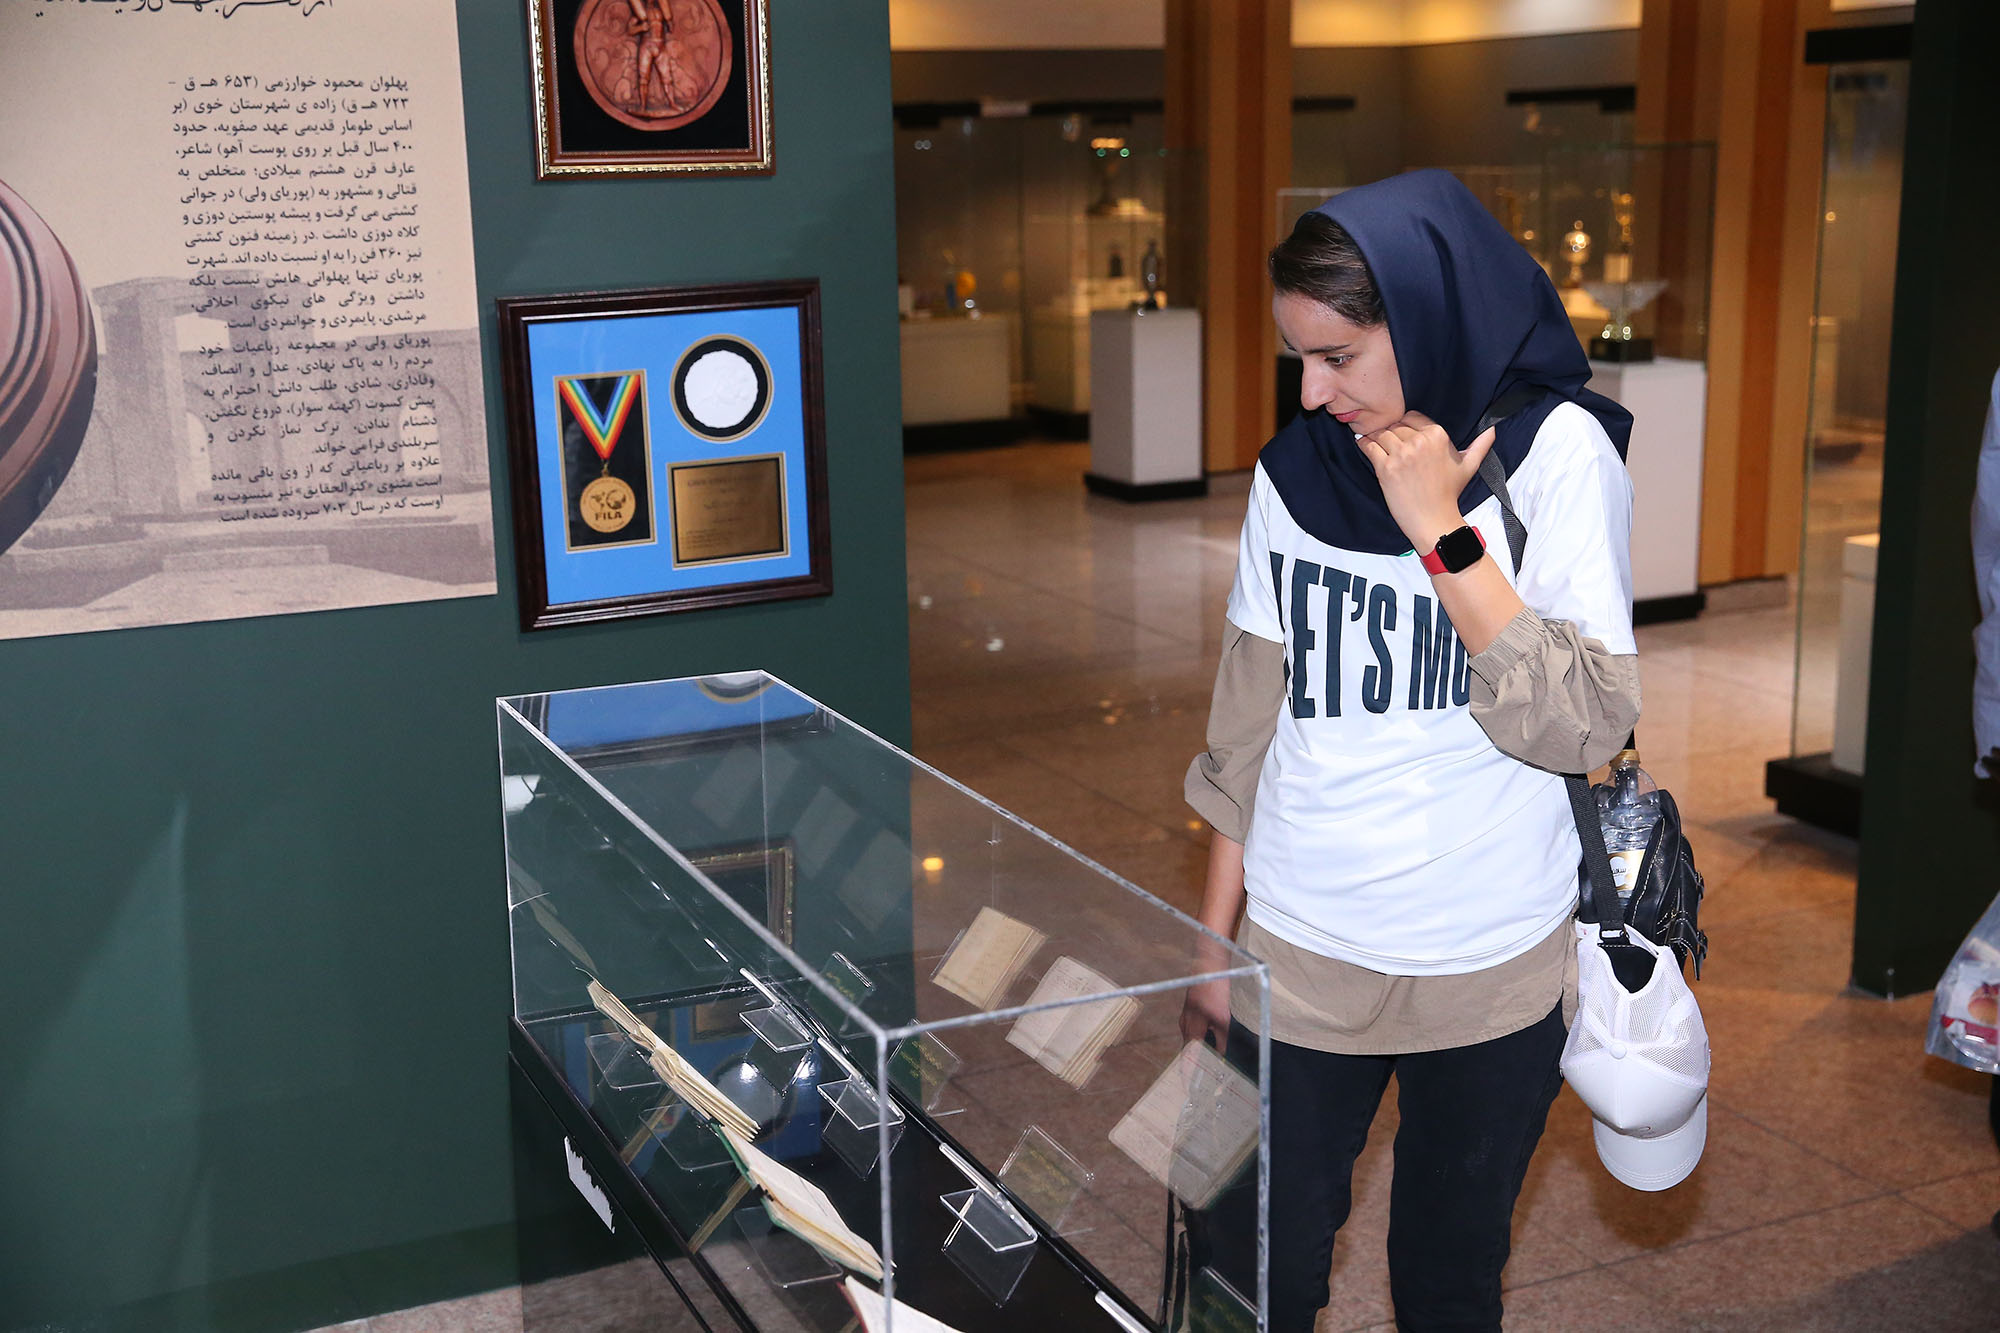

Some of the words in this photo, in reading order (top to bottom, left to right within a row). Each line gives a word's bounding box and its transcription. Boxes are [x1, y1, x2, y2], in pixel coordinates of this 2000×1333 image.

[184, 76, 196, 92] ق
[264, 75, 317, 93] خوارزمی
[323, 78, 364, 92] محمود
[370, 75, 409, 93] پهلوان
[193, 98, 224, 115] خوی
[229, 97, 290, 115] شهرستان
[296, 102, 307, 114] ی
[312, 97, 336, 114] زاده
[173, 123, 208, 137] حدود
[262, 123, 289, 136] عهد
[294, 119, 335, 137] قدیمی
[340, 119, 373, 136] طومار
[378, 119, 412, 136] اساس
[248, 145, 288, 159] پوست
[292, 146, 317, 158] روی
[321, 146, 332, 158] بر
[336, 140, 360, 157] قبل
[363, 141, 389, 157] سال
[393, 140, 412, 152] ۴۰۰
[177, 168, 190, 181] به
[198, 164, 247, 182] متخلص
[309, 163, 346, 179] هشتم
[353, 162, 377, 179] قرن
[384, 162, 415, 178] عارف
[180, 186, 217, 204] جوانی
[222, 189, 235, 203] در
[318, 188, 330, 200] به
[333, 184, 374, 201] مشهور
[377, 189, 384, 200] و
[386, 183, 417, 200] قتالی
[182, 214, 190, 226] و
[192, 211, 226, 225] دوزی
[228, 210, 277, 225] پوستین
[279, 207, 312, 223] پیشه
[315, 211, 322, 223] و
[323, 205, 358, 222] گرفت
[361, 210, 379, 222] می
[381, 204, 418, 222] کشتی
[184, 230, 224, 248] کشتی
[228, 229, 259, 247] فنون
[263, 231, 298, 245] زمینه
[322, 227, 358, 240] داشت
[362, 228, 393, 243] دوزی
[397, 225, 420, 238] کلاه
[186, 252, 228, 269] شهرت
[231, 251, 251, 264] اند.
[253, 250, 278, 263] داده
[280, 250, 318, 265] نسبت
[321, 249, 331, 265] او
[333, 252, 345, 264] به
[346, 248, 357, 264] را
[359, 247, 376, 264] فن
[378, 247, 401, 259] ۳۶۰
[406, 247, 422, 263] نیز
[188, 274, 217, 291] بلکه
[222, 273, 260, 289] نیست
[265, 271, 301, 289] هایش
[306, 270, 351, 288] پهلوانی
[355, 269, 379, 285] تنها
[385, 268, 423, 284] پوریای
[250, 293, 290, 311] نیکوی
[301, 292, 326, 309] های
[338, 290, 376, 308] ویژگی
[387, 288, 425, 305] داشتن
[224, 315, 256, 329] است.
[258, 314, 317, 332] جوانمردی
[320, 317, 327, 329] و
[328, 311, 376, 328] پایمردی
[232, 339, 280, 356] رباعیات
[287, 341, 336, 354] مجموعه
[344, 339, 358, 352] در
[364, 335, 386, 352] ولی
[393, 333, 432, 350] پوریای
[198, 342, 226, 359] خود
[262, 360, 290, 377] عدل
[342, 356, 365, 372] پاک
[370, 359, 383, 370] به
[389, 355, 399, 370] را
[405, 356, 434, 369] مردم
[249, 367, 256, 378] و
[203, 389, 215, 401] به
[221, 382, 261, 400] احترام
[309, 379, 338, 395] طلب
[365, 395, 404, 413] کسوت
[408, 395, 436, 411] پیش
[251, 404, 282, 421] دروغ
[278, 423, 302, 439] نماز
[402, 415, 438, 431] دشنام
[207, 432, 214, 445] و
[227, 424, 266, 443] نکردن
[311, 440, 347, 457] خواند.
[349, 444, 368, 456] می
[368, 438, 386, 454] فرا
[387, 436, 440, 454] سربلندی
[304, 463, 314, 479] از
[319, 461, 334, 474] که
[340, 458, 389, 479] رباعیاتی
[395, 461, 405, 474] بر
[410, 455, 440, 471] علاوه
[211, 468, 242, 484] مانده
[248, 466, 274, 484] باقی
[278, 465, 298, 481] وی
[415, 474, 442, 487] است
[376, 478, 413, 494] مثنوی
[213, 493, 225, 505] به
[227, 488, 274, 505] منسوب
[277, 486, 294, 503] نیز
[393, 496, 407, 509] که
[410, 492, 444, 510] اوست
[251, 507, 279, 520] شده
[281, 507, 322, 521] سروده
[350, 500, 375, 516] سال
[378, 501, 391, 514] در
[594, 510, 623, 521] FILA
[218, 509, 250, 523] است.
